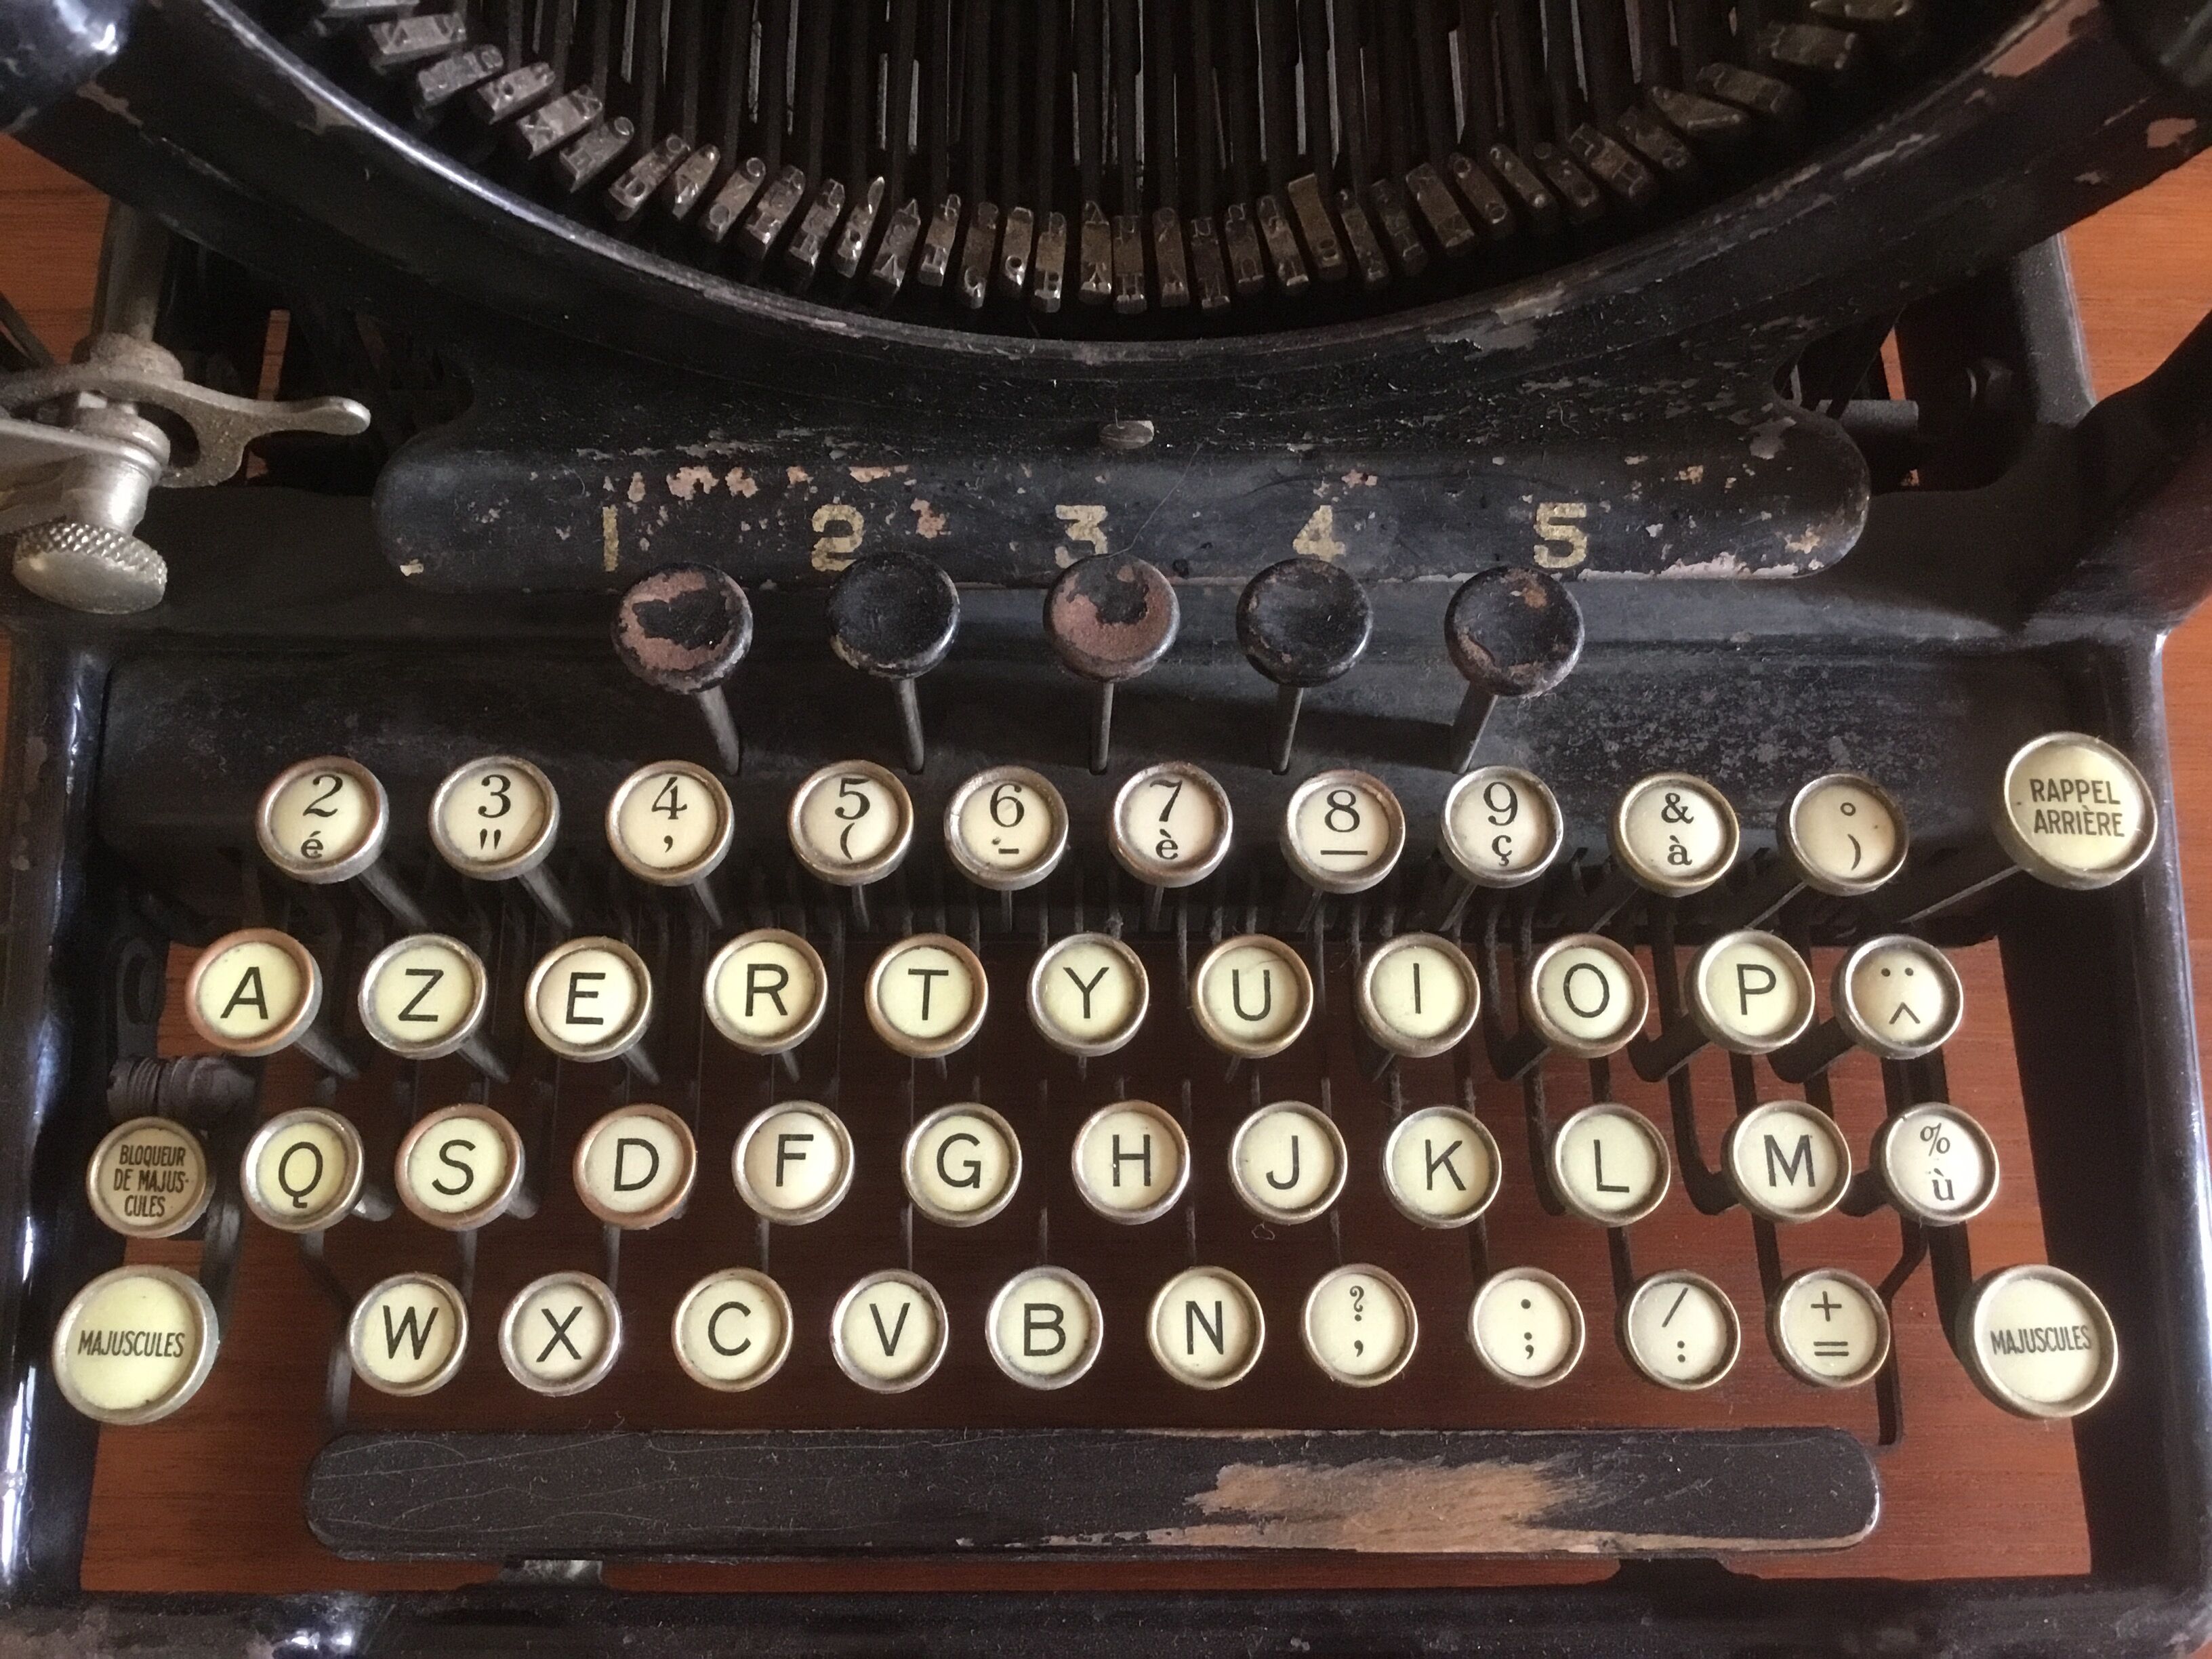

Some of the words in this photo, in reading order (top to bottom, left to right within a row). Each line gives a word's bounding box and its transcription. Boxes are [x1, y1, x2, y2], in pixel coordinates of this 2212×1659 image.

[812, 504, 865, 571] 2
[1054, 504, 1107, 569] 3
[1293, 504, 1346, 562] 4
[1534, 502, 1587, 569] 5
[303, 774, 343, 817] 2
[478, 774, 511, 818] 3
[651, 776, 687, 820] 4
[834, 778, 871, 820] 5
[989, 783, 1025, 827] 6
[1149, 780, 1183, 823] 7
[1325, 790, 1360, 832] 8
[1483, 781, 1518, 826] 9
[1661, 793, 1694, 823] &
[2029, 778, 2120, 804] RAPPEL
[301, 831, 323, 859] é
[1155, 829, 1178, 860] è
[2034, 806, 2123, 836] ARRIÈRE
[1491, 835, 1513, 865] ç
[1668, 835, 1692, 865] à
[220, 967, 268, 1020] A
[398, 968, 444, 1022] Z
[566, 972, 606, 1025] E
[745, 964, 789, 1017] R
[908, 968, 949, 1021] T
[1063, 967, 1109, 1019] Y
[1232, 969, 1271, 1021] U
[1563, 963, 1610, 1018] O
[1737, 964, 1776, 1015] P
[119, 1145, 186, 1168] BLOQUEUR
[614, 1138, 659, 1191] D
[776, 1134, 814, 1187] F
[937, 1133, 981, 1189] G
[1113, 1134, 1151, 1187] H
[1266, 1136, 1299, 1189] J
[1425, 1139, 1467, 1191] K
[1764, 1134, 1816, 1187] M
[1920, 1123, 1950, 1155] %
[114, 1169, 134, 1191] DE
[278, 1141, 324, 1208] Q
[432, 1139, 476, 1195] S
[1594, 1139, 1629, 1193] L
[1932, 1168, 1954, 1201] ù
[125, 1195, 165, 1217] CULES
[78, 1330, 187, 1359] MAJUSCULES
[382, 1305, 439, 1361] W
[536, 1307, 583, 1362] X
[708, 1302, 751, 1356] C
[869, 1303, 910, 1356] V
[1024, 1303, 1066, 1356] B
[1186, 1301, 1224, 1355] N
[1990, 1324, 2093, 1357] MAJUSCULES
